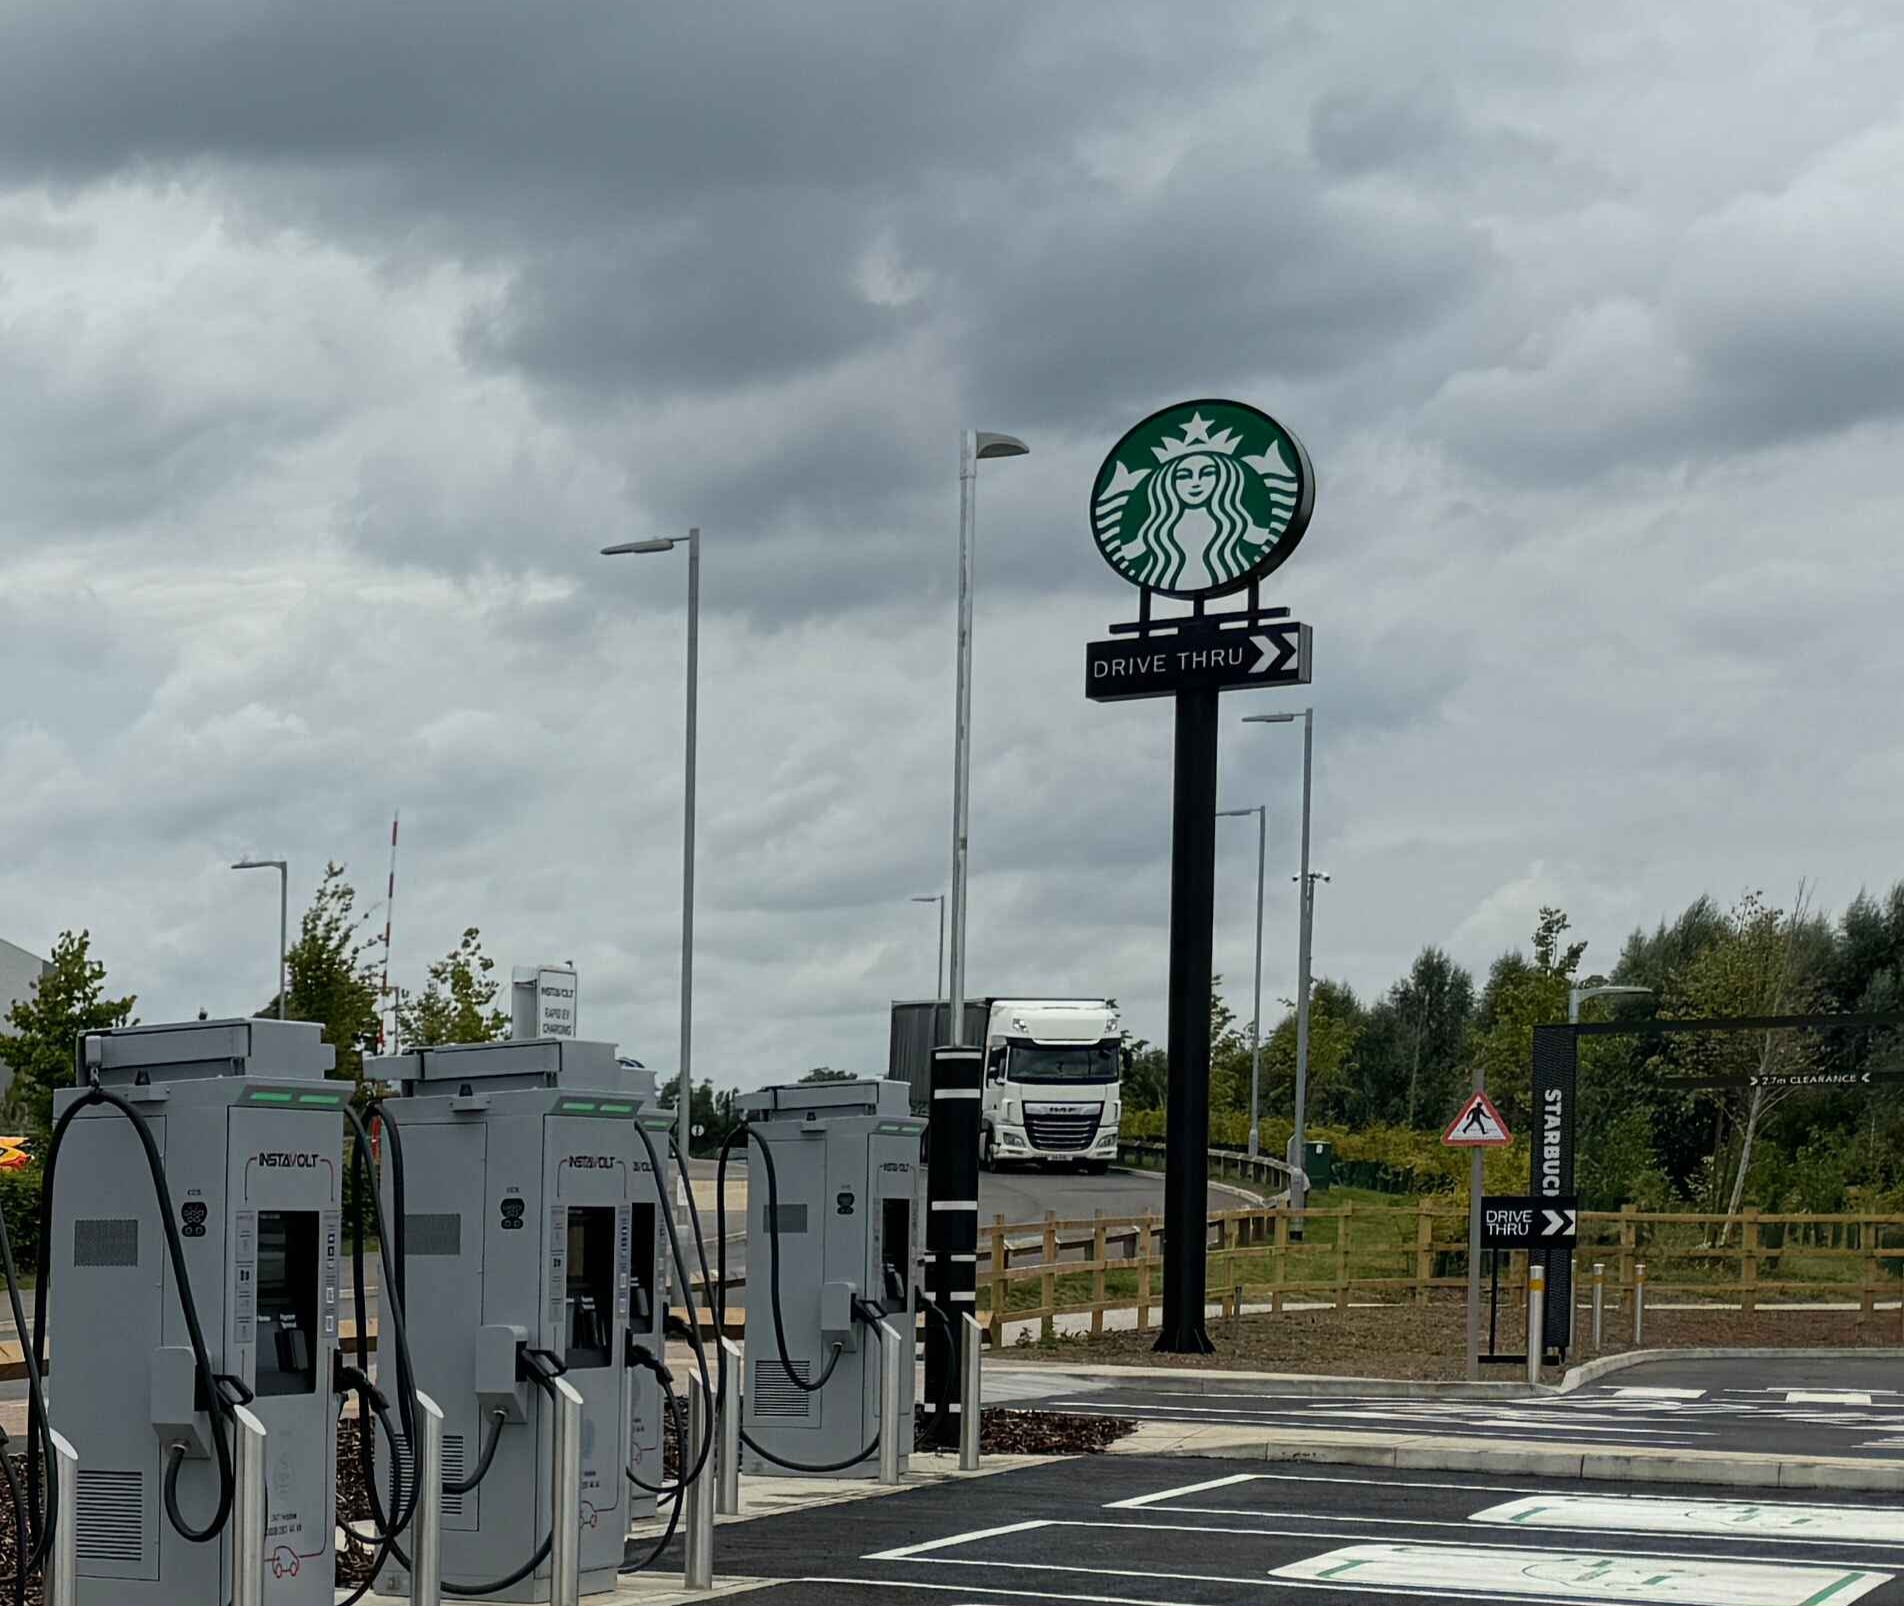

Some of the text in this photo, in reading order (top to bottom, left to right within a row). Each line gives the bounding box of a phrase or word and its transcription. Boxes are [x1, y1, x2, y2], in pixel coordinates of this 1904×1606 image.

[1094, 646, 1243, 678] DRIVE THRU
[1789, 1074, 1857, 1085] CLEARANCE
[258, 1153, 320, 1168] INSTAVOLT
[1486, 1209, 1534, 1223] DRIVE
[1486, 1222, 1530, 1236] THRU
